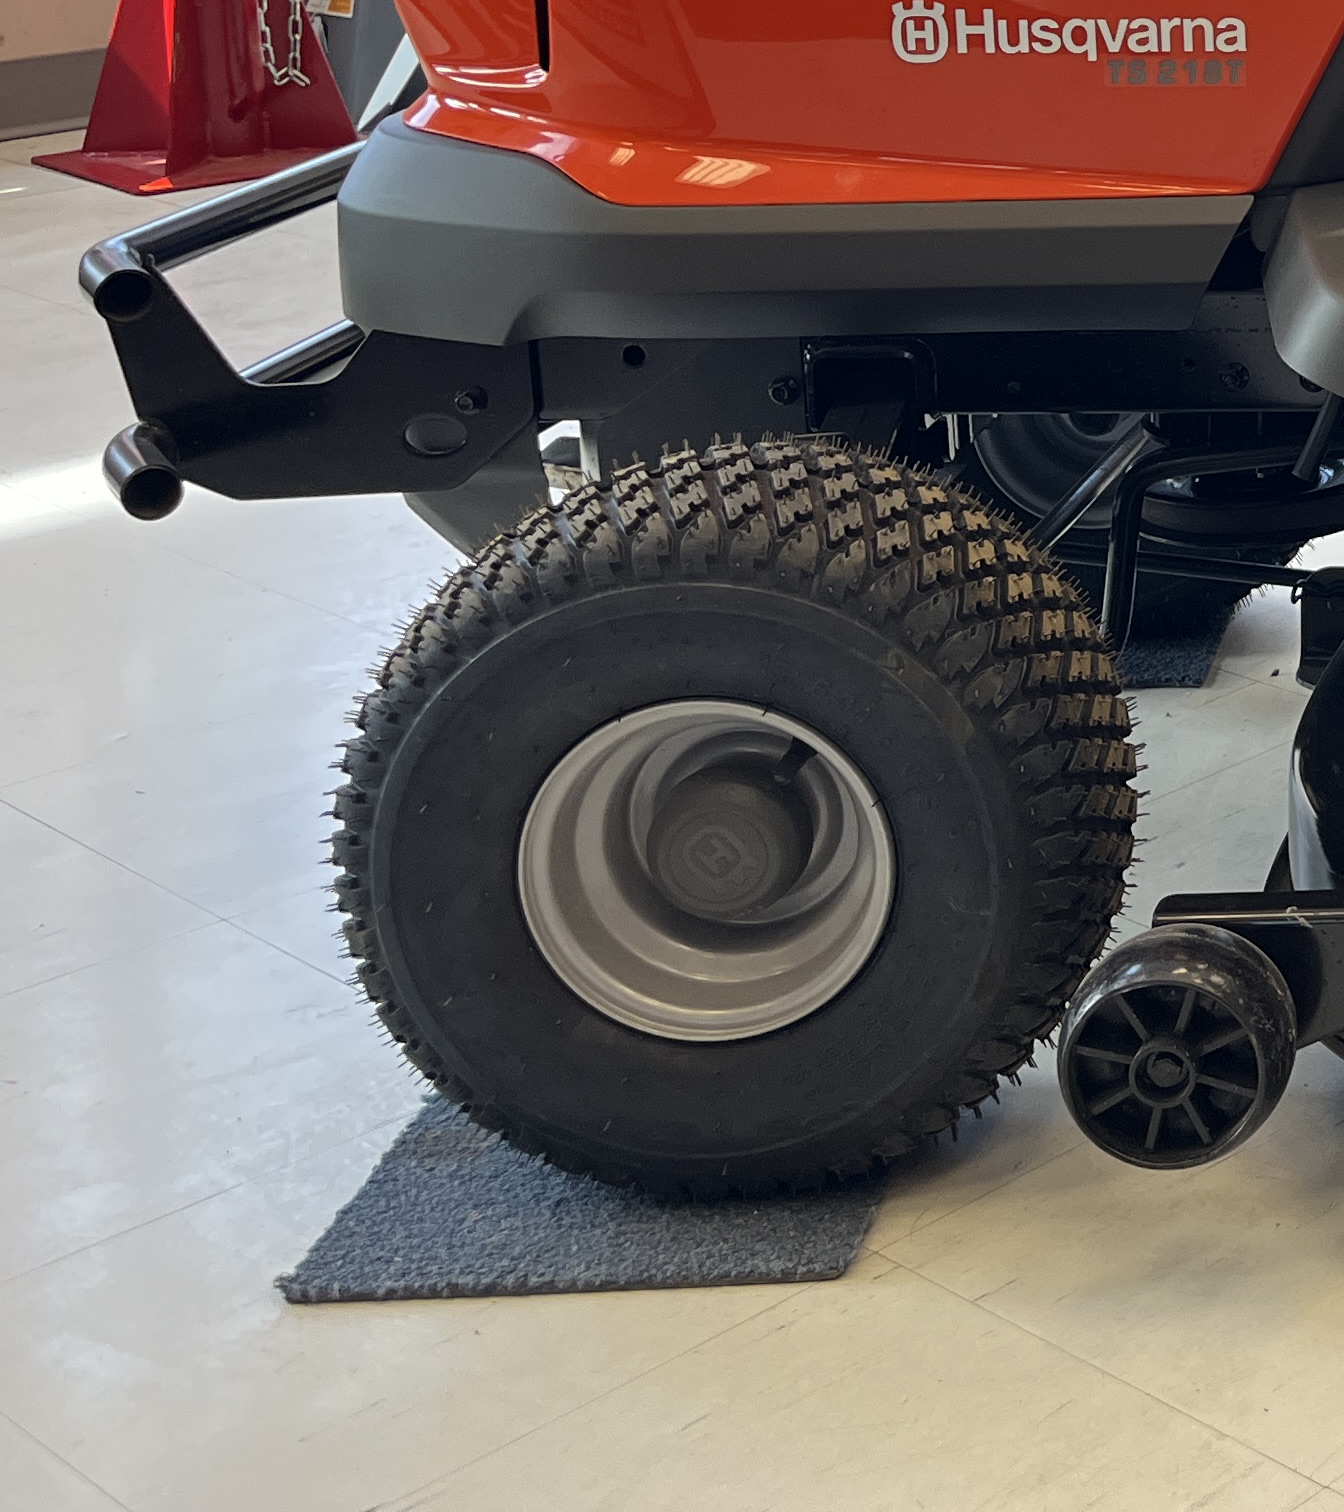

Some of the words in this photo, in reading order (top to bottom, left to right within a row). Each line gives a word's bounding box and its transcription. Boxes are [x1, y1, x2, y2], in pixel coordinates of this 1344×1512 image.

[954, 8, 1247, 62] Husqvarna
[1107, 59, 1148, 85] TS
[1157, 59, 1244, 85] 218T
